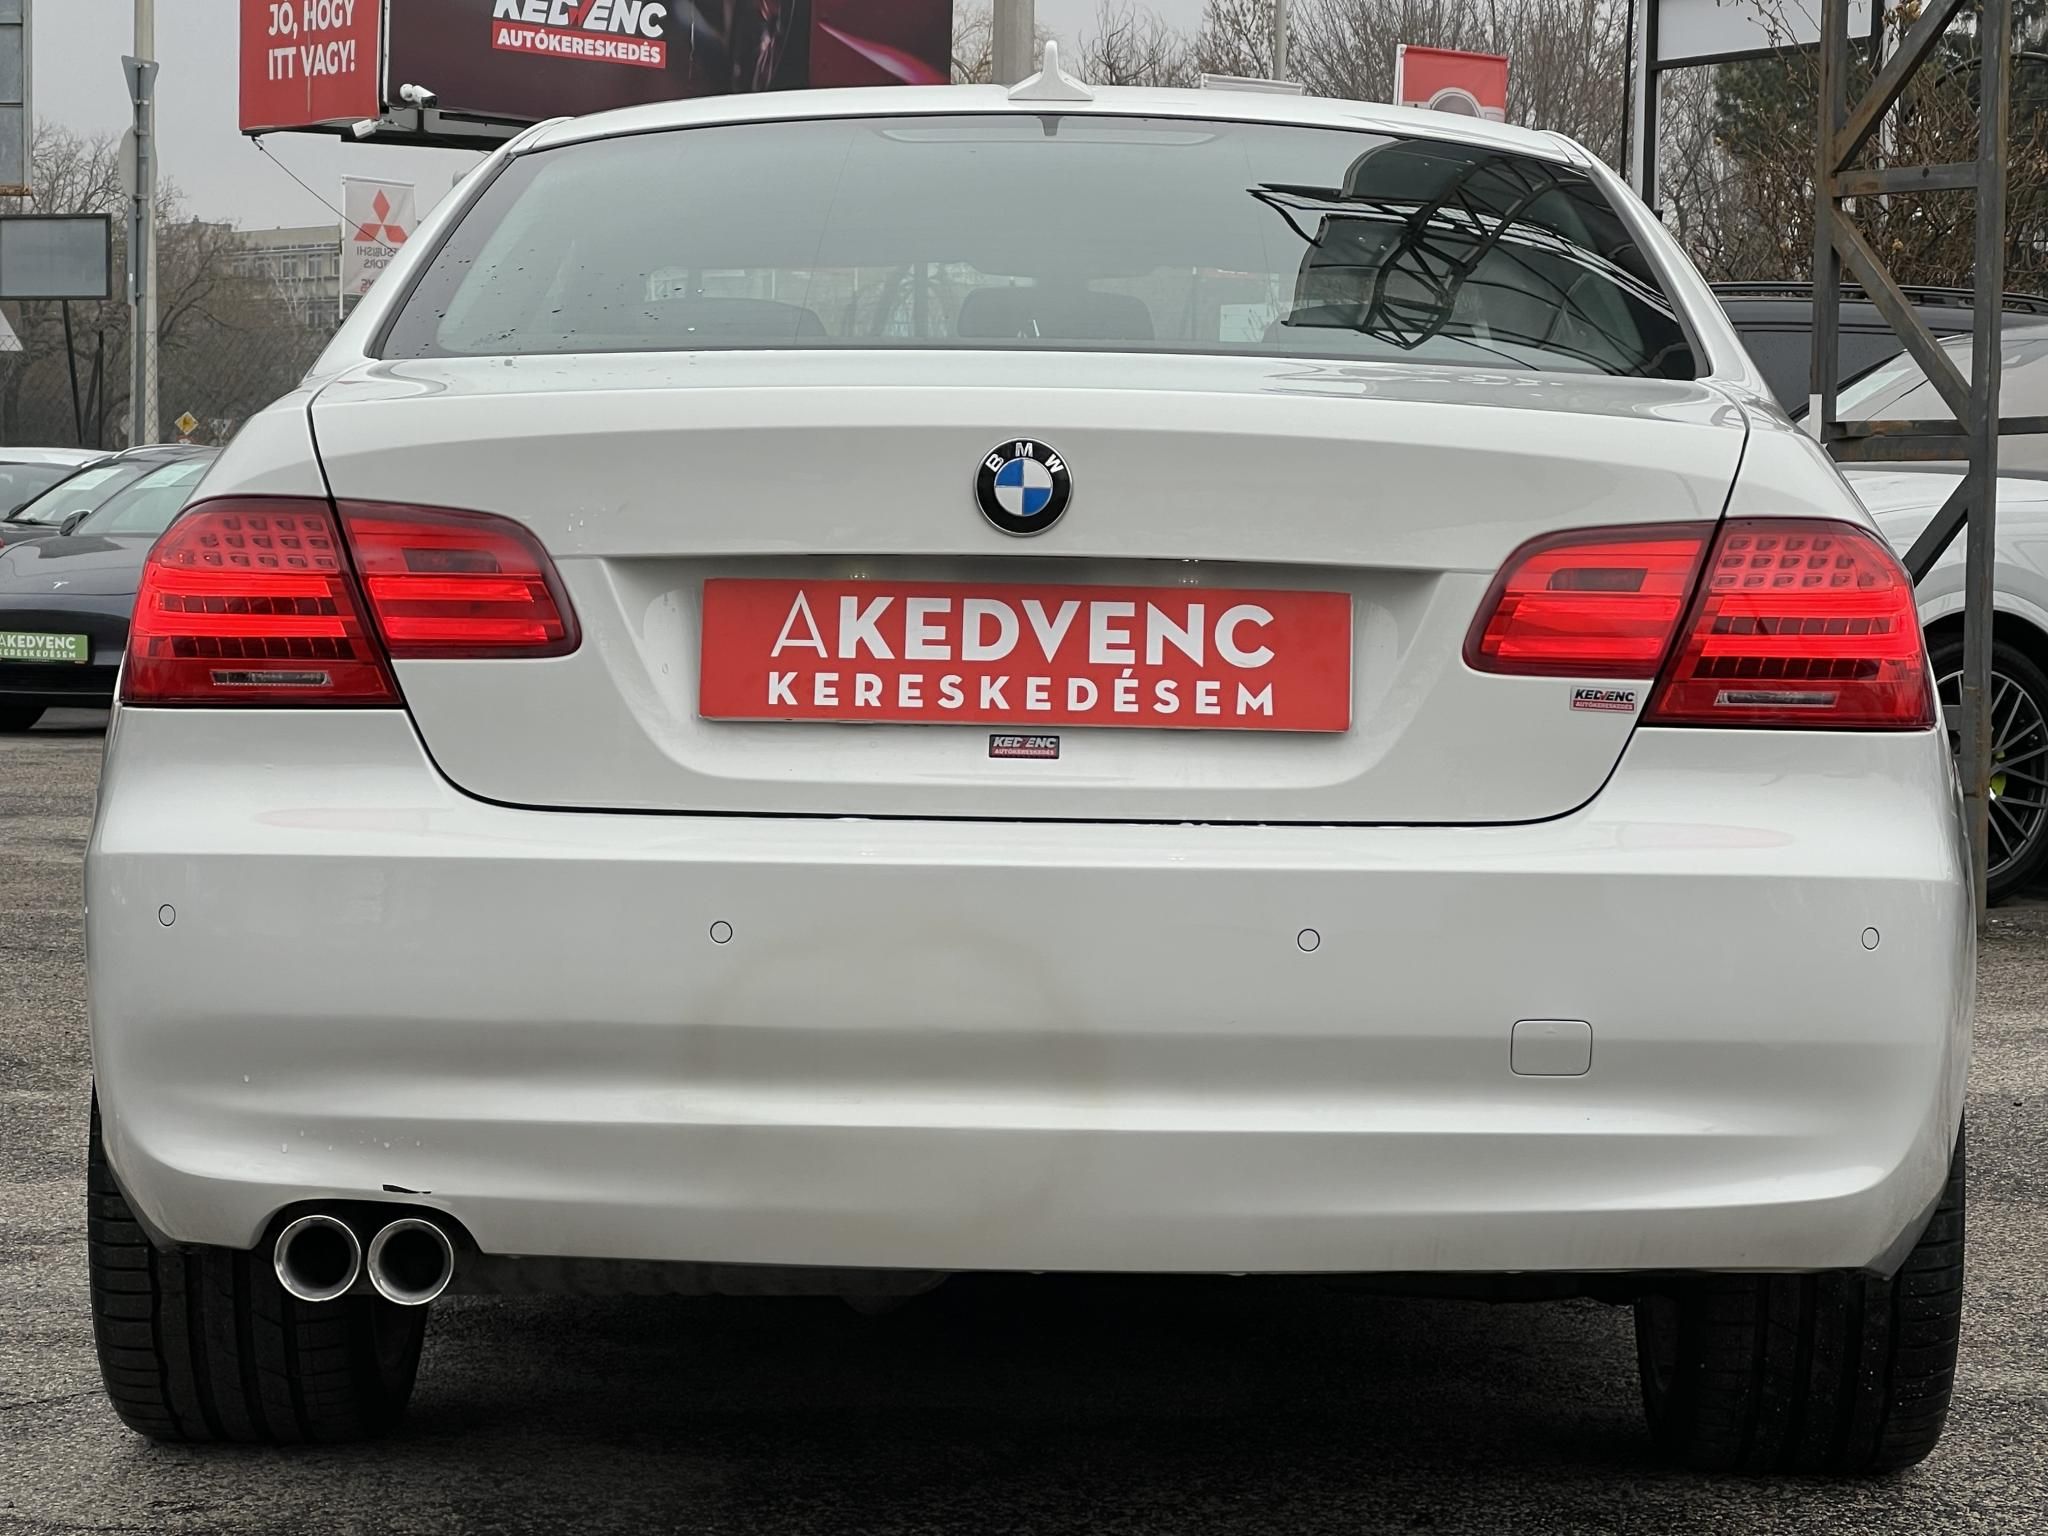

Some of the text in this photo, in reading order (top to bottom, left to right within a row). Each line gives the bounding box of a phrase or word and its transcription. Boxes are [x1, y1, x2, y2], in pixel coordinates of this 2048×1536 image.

[303, 0, 355, 31] HOGY
[268, 39, 356, 80] ITT VAGY!
[497, 28, 662, 64] AUTÓKERESKEDÉS
[984, 442, 1065, 473] BMW
[0, 648, 77, 659] ERESKEDÉSEM
[767, 668, 1274, 717] KERESKEDÉSEM
